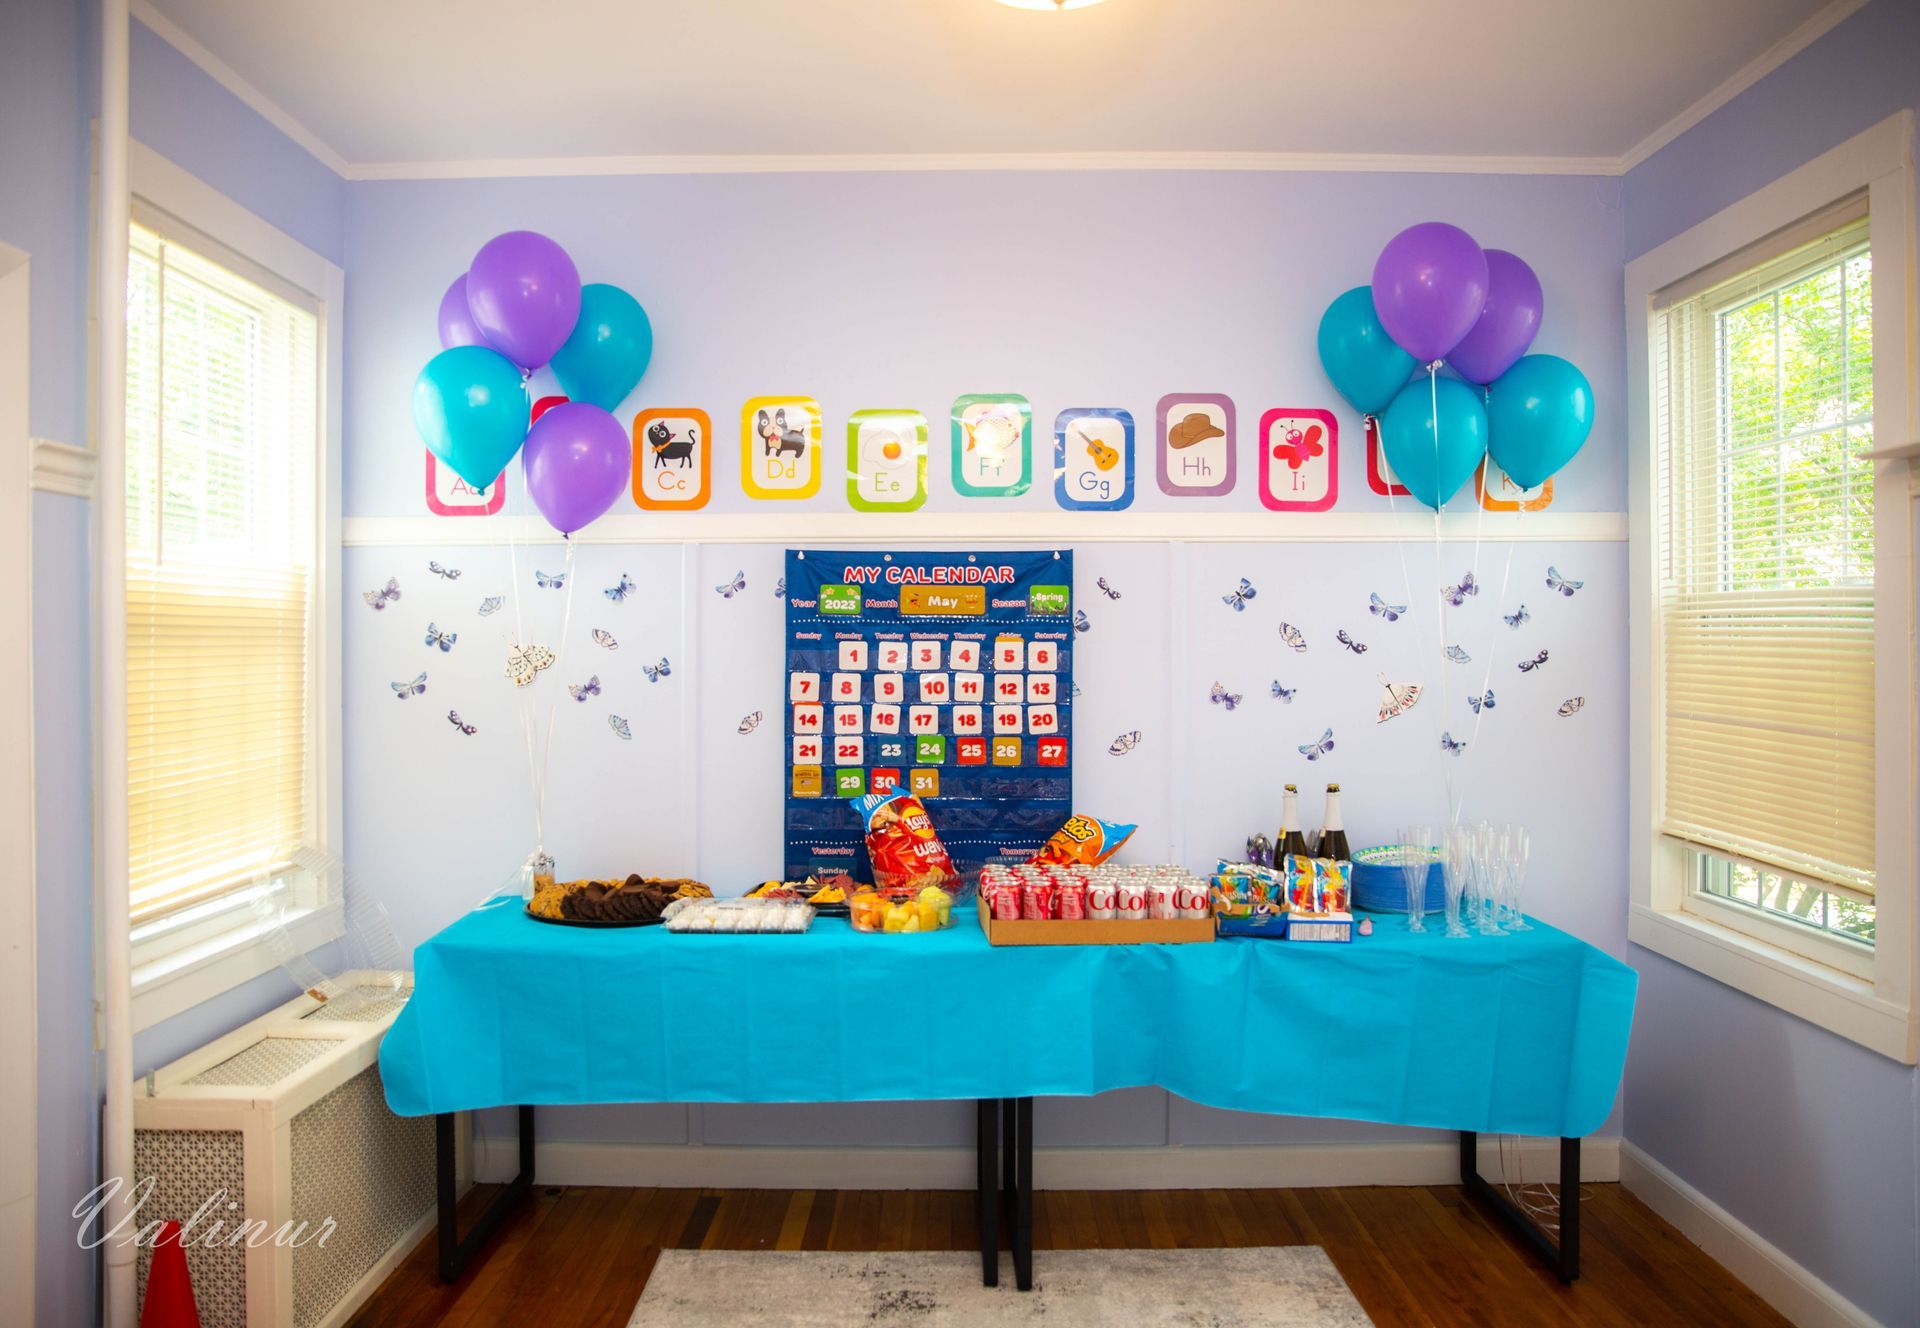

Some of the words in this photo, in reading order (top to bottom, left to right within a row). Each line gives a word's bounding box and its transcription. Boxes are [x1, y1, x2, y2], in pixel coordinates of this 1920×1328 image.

[767, 459, 795, 480] Dd
[1183, 457, 1211, 477] Hh
[657, 471, 686, 491] Cc
[874, 472, 900, 492] Ee
[1079, 471, 1111, 499] Gg
[1292, 471, 1306, 491] Ii
[843, 566, 882, 584] MY
[885, 566, 1015, 584] CALENDAR
[791, 598, 817, 609] Year
[865, 599, 899, 609] Month
[927, 596, 959, 609] May
[991, 599, 1026, 608] Season
[1036, 592, 1065, 603] Spring
[824, 599, 856, 610] 2023
[795, 632, 822, 640] Sunday
[835, 632, 863, 640] Monday
[875, 632, 904, 640] Tuesday
[910, 632, 949, 640] Wednesday
[954, 632, 986, 640] Thursday
[1034, 632, 1068, 640] Saturday
[849, 650, 858, 663] 1
[887, 650, 899, 663] 2
[921, 650, 932, 663] 3
[959, 649, 971, 663] 4
[1004, 650, 1015, 663] 5
[1037, 650, 1048, 663] 6
[800, 681, 811, 694] 7
[841, 681, 852, 694] 8
[883, 681, 895, 695] 9
[924, 681, 945, 694] 10
[962, 682, 977, 694] 11
[999, 682, 1017, 695] 12
[1032, 683, 1050, 695] 13
[798, 713, 818, 726] 14
[839, 713, 857, 726] 15
[876, 713, 895, 725] 16
[914, 714, 932, 726] 17
[958, 714, 976, 726] 18
[999, 713, 1017, 726] 19
[1032, 713, 1053, 726] 20
[799, 744, 817, 757] 21
[838, 745, 859, 757] 22
[881, 744, 902, 756] 23
[920, 743, 941, 756] 24
[962, 744, 982, 757] 25
[996, 745, 1017, 757] 26
[1041, 745, 1062, 757] 27
[840, 776, 861, 789] 29
[874, 776, 895, 789] 30
[916, 776, 933, 789] 31
[1063, 817, 1095, 840] etos
[811, 847, 855, 856] Yesterday
[817, 866, 849, 875] Sunday
